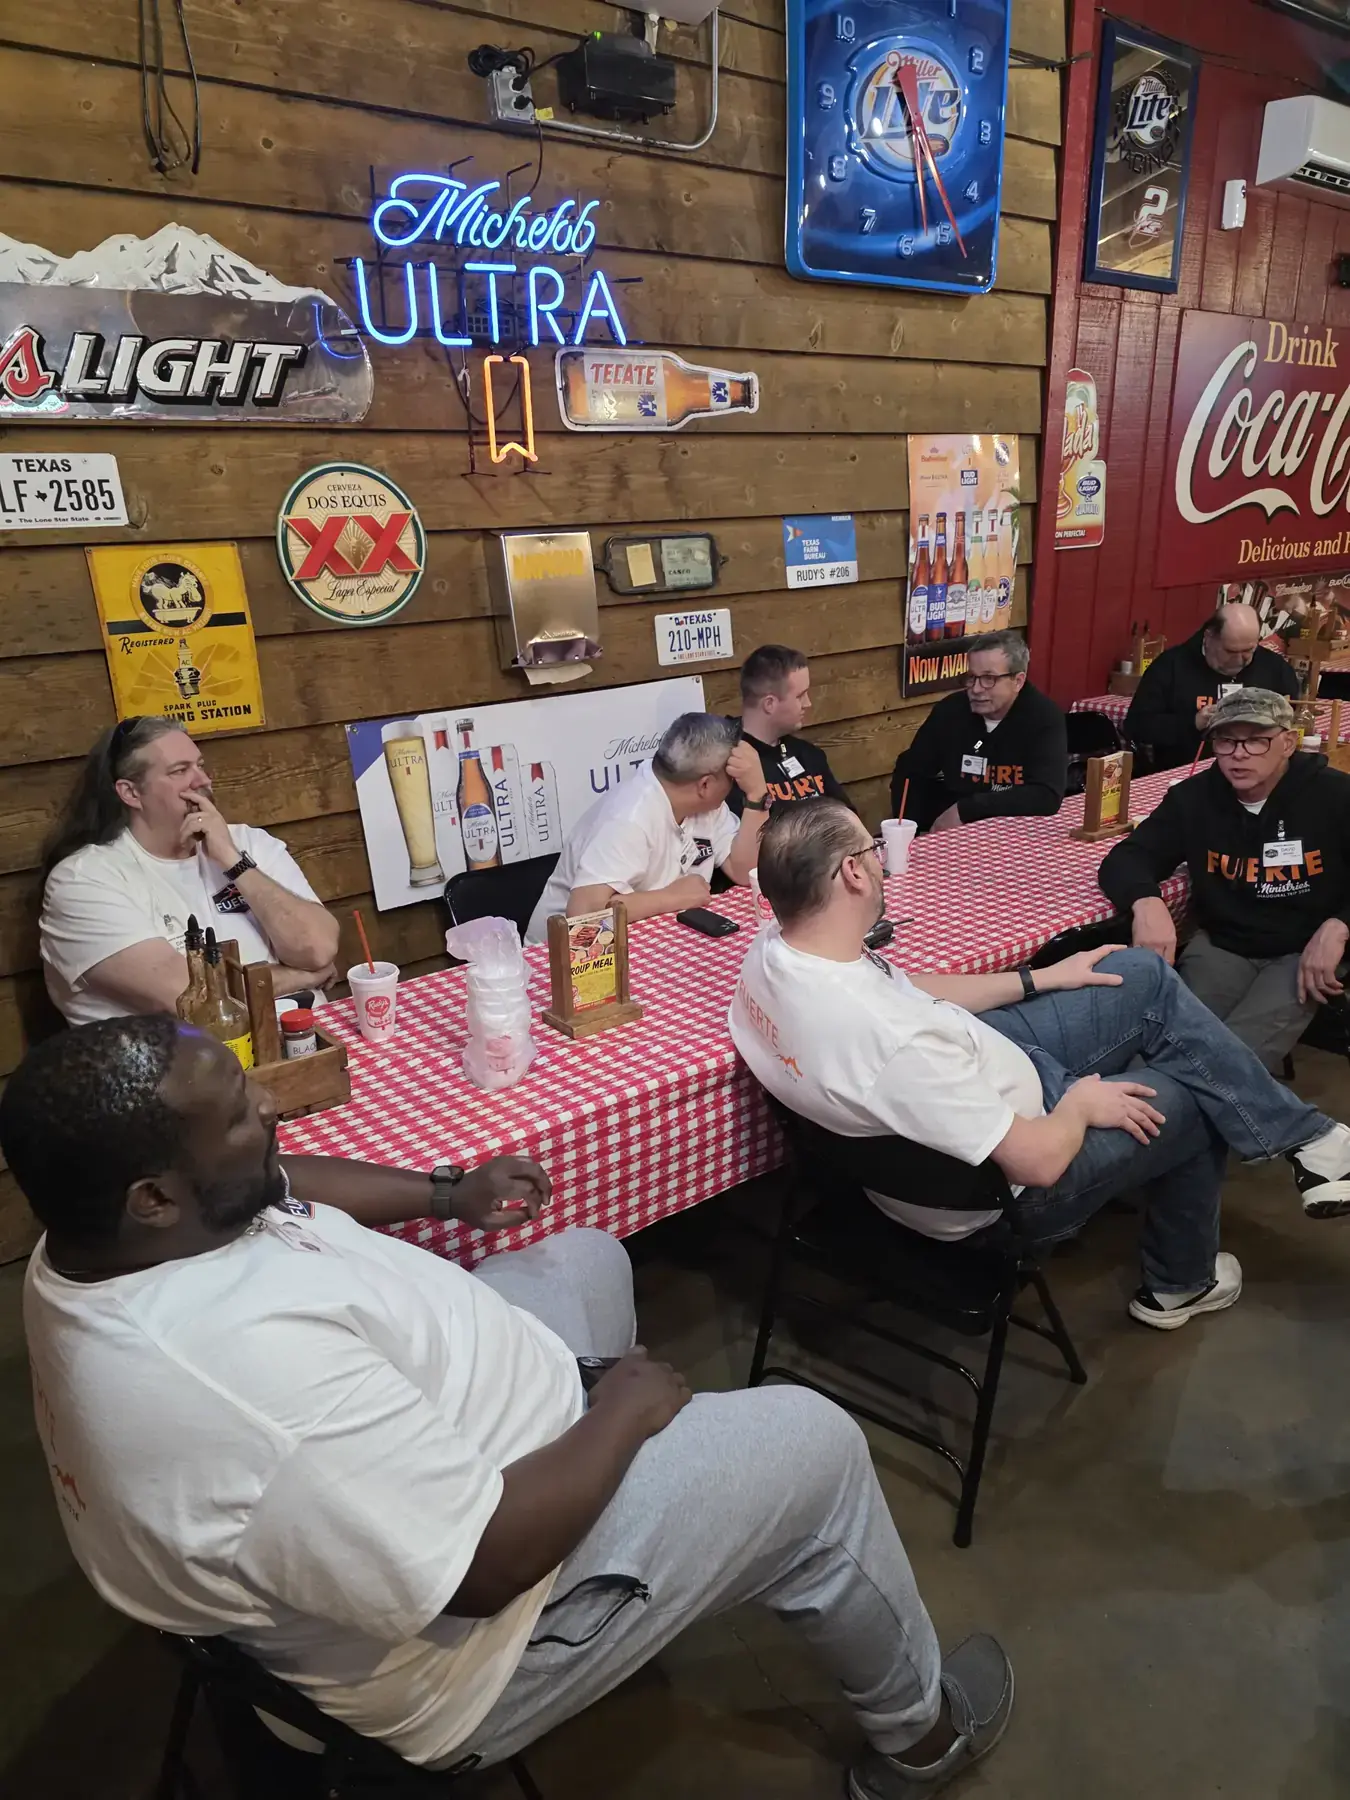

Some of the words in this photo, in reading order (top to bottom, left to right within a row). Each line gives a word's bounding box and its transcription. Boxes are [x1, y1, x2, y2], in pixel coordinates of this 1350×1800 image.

[837, 14, 856, 39] 10
[971, 48, 984, 73] 2
[820, 83, 836, 108] 9
[1141, 78, 1166, 93] Miller
[861, 80, 962, 139] Lte
[1126, 94, 1172, 129] Lite
[979, 120, 992, 143] 3
[831, 157, 847, 180] 8
[965, 180, 980, 203] 4
[861, 208, 877, 233] 7
[936, 223, 951, 246] 5
[899, 236, 914, 258] 6
[355, 256, 627, 347] ULTRA
[1264, 321, 1340, 368] Drink
[60, 331, 308, 406] LIGHT
[590, 362, 657, 386] TECATE
[12, 458, 72, 473] TEXAS
[327, 484, 362, 492] CERVEZA
[961, 477, 978, 485] LIGHT
[49, 478, 115, 512] 2585
[307, 496, 338, 509] DOS
[342, 494, 387, 508] EQUIS
[285, 512, 422, 580] XX
[802, 538, 820, 546] TEXAS
[803, 545, 819, 553] FARM
[1237, 538, 1311, 564] Delicious
[1313, 533, 1340, 556] and
[804, 552, 826, 560] BUREAU
[796, 568, 825, 582] RUDY'S
[829, 566, 850, 579] #206
[324, 578, 355, 604] Lager
[356, 577, 400, 601] Especial
[911, 603, 926, 613] ULTR
[929, 602, 945, 610] BUD
[683, 613, 713, 625] TEXAS
[668, 625, 721, 653] 210-MPH
[909, 655, 940, 685] NOW
[940, 652, 969, 679] AVAI
[164, 702, 192, 711] SPARK
[197, 699, 217, 708] PLUG
[201, 704, 252, 720] STATION
[390, 755, 424, 769] ULTRA
[494, 778, 515, 848] ULTRA
[534, 785, 550, 843] ULTRA
[464, 825, 497, 839] ULTRA
[571, 962, 591, 977] ROUP
[592, 957, 614, 970] MEAL
